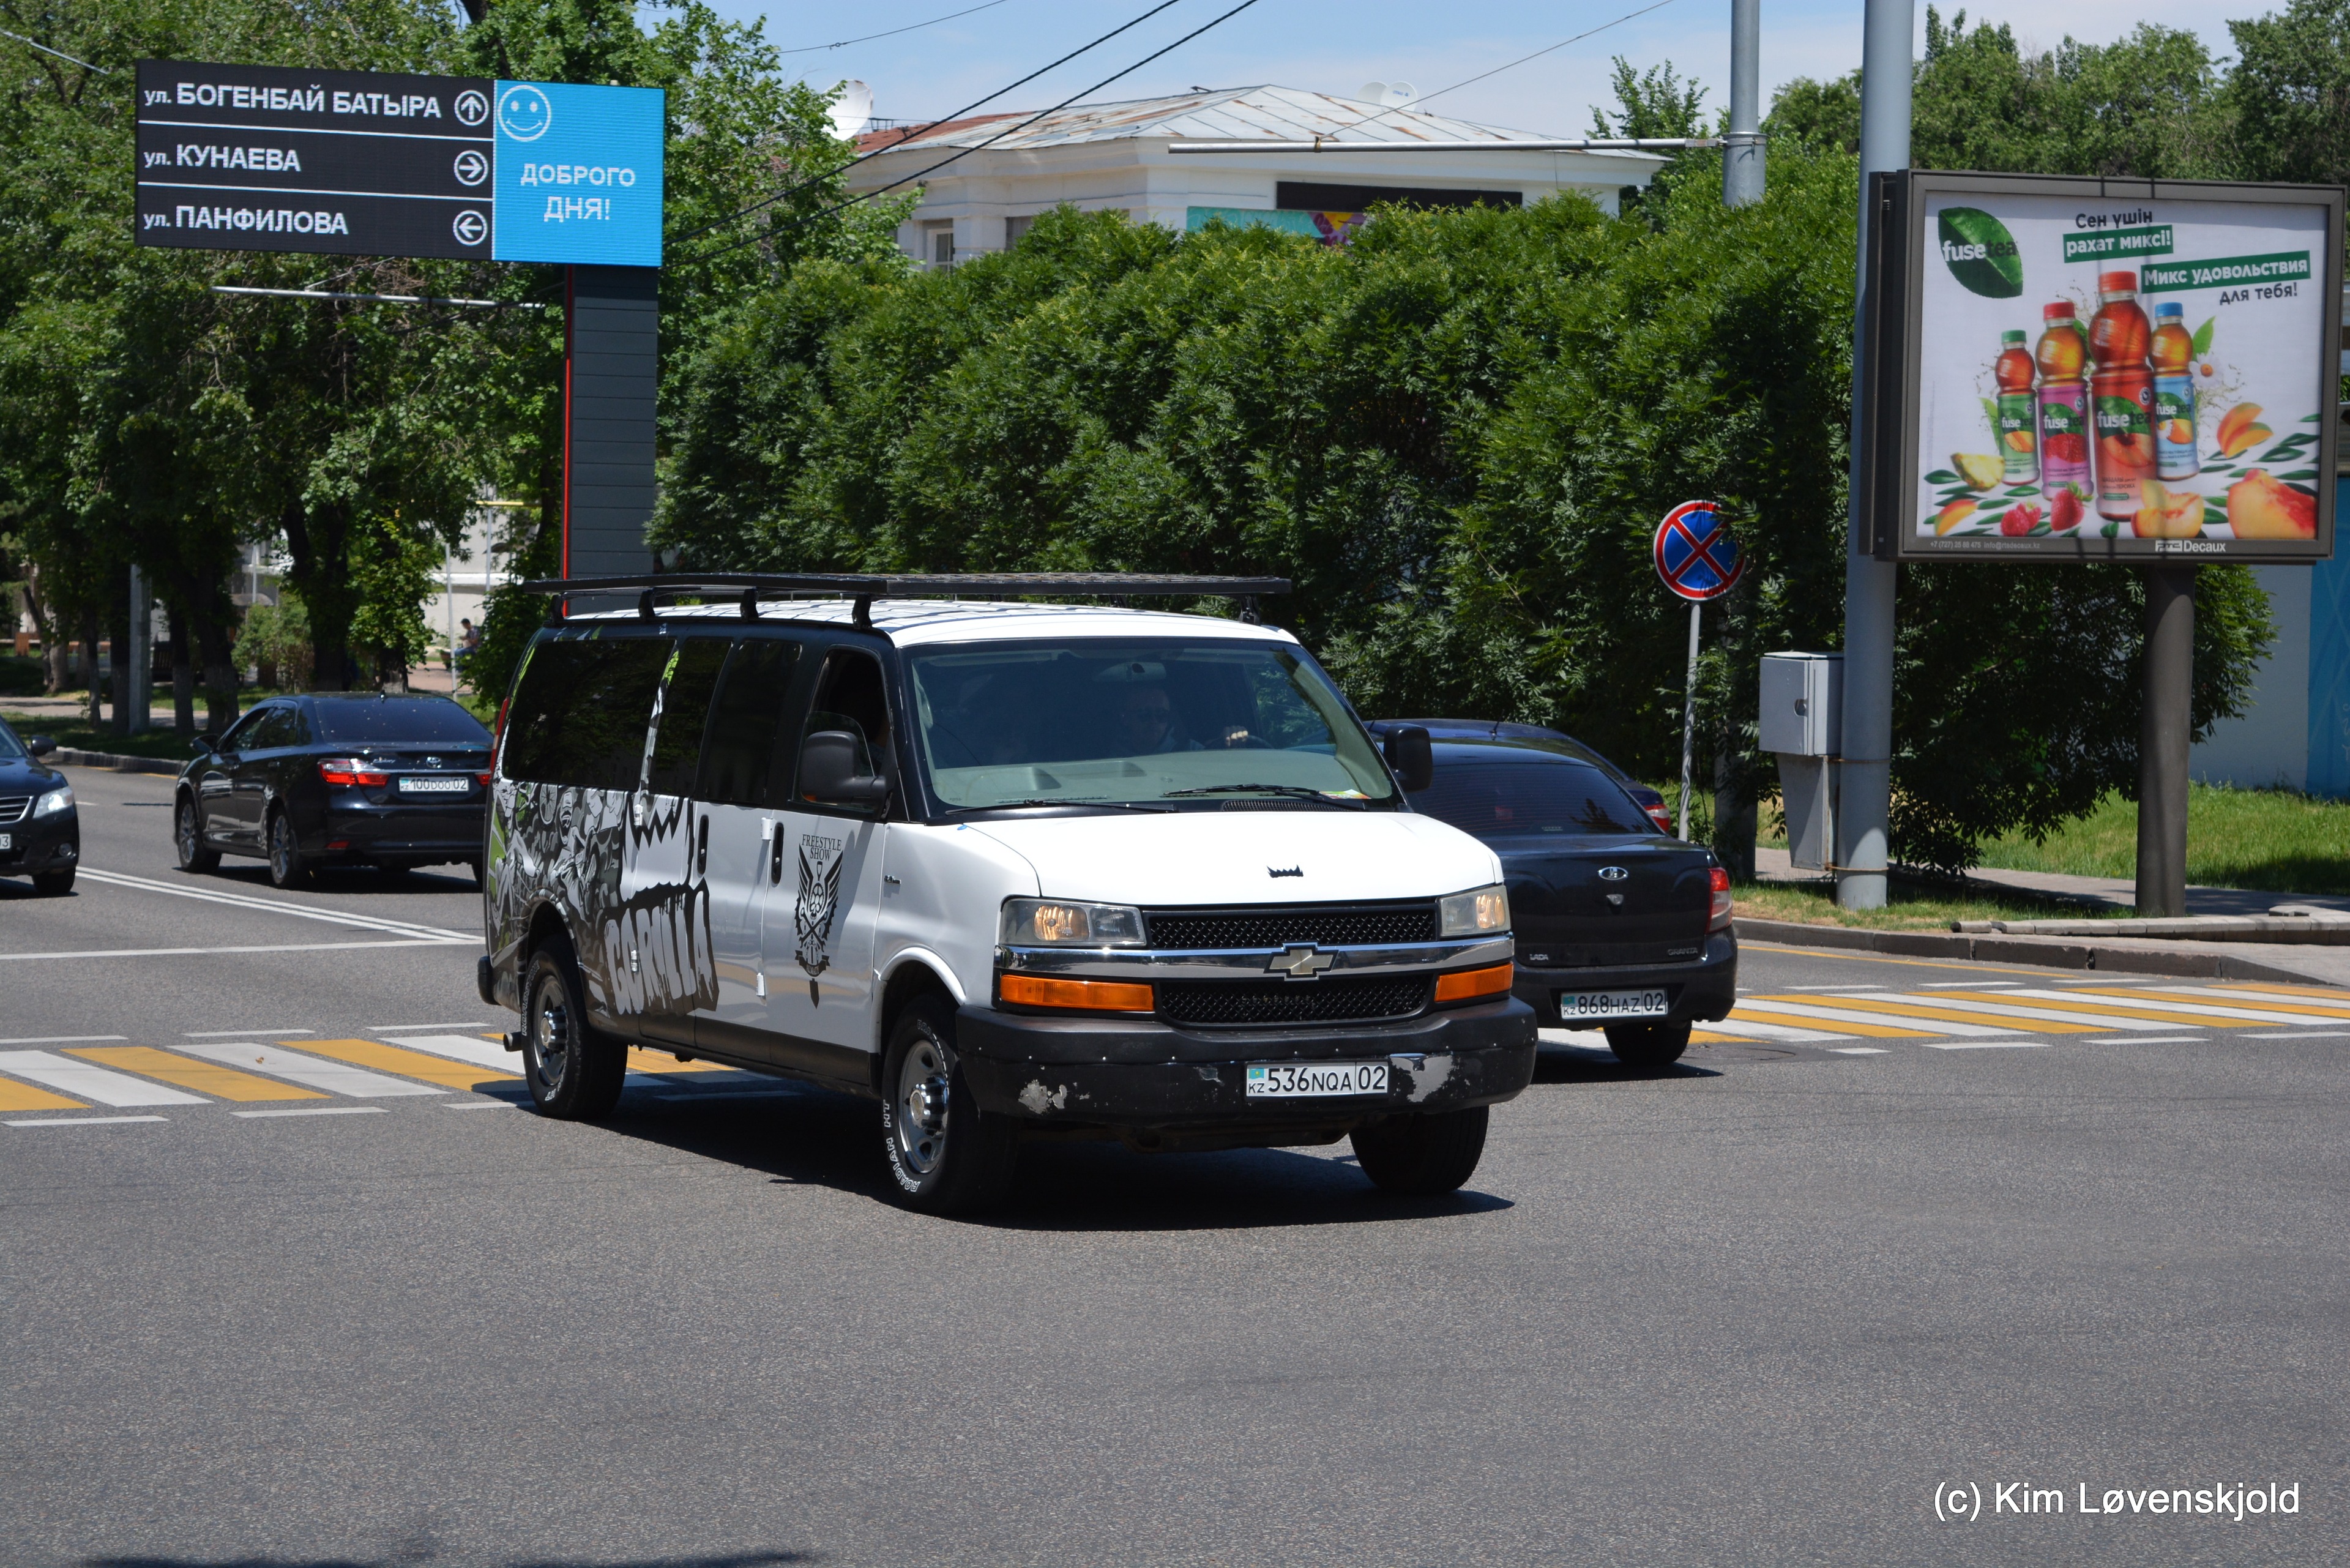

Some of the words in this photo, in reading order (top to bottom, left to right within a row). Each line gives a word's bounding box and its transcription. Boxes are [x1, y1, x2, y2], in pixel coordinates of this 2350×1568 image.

[144, 90, 172, 106] ул.
[177, 83, 324, 112] БОГЕНБАЙ
[333, 91, 442, 118] БАТЫРА
[143, 152, 171, 168] ул.
[176, 144, 301, 172] КУНАЕВА
[520, 163, 636, 187] ДОБРОГО
[143, 214, 171, 230] ул.
[176, 205, 349, 235] ПАНФИЛОВА
[543, 196, 610, 223] ДНЯ!
[2075, 212, 2107, 229] Сен
[2114, 208, 2153, 229] үшін
[2066, 237, 2114, 257] рахат
[2119, 230, 2171, 250] миксі!
[2144, 268, 2187, 286] Микс
[2192, 258, 2308, 285] удовольствия
[2220, 288, 2250, 306] для
[2255, 282, 2298, 300] тебя!
[2184, 540, 2226, 552] Decaux
[453, 778, 467, 790] 02
[802, 834, 842, 851] FREESTYLE
[810, 847, 832, 862] SHOW
[1667, 947, 1698, 956] GRANTA
[1563, 1007, 1576, 1015] KZ
[1578, 994, 1640, 1015] 868HAZ
[1644, 992, 1664, 1012] 02
[1248, 1083, 1265, 1094] KZ
[1267, 1067, 1352, 1092] 536NQA
[1358, 1066, 1386, 1090] 02
